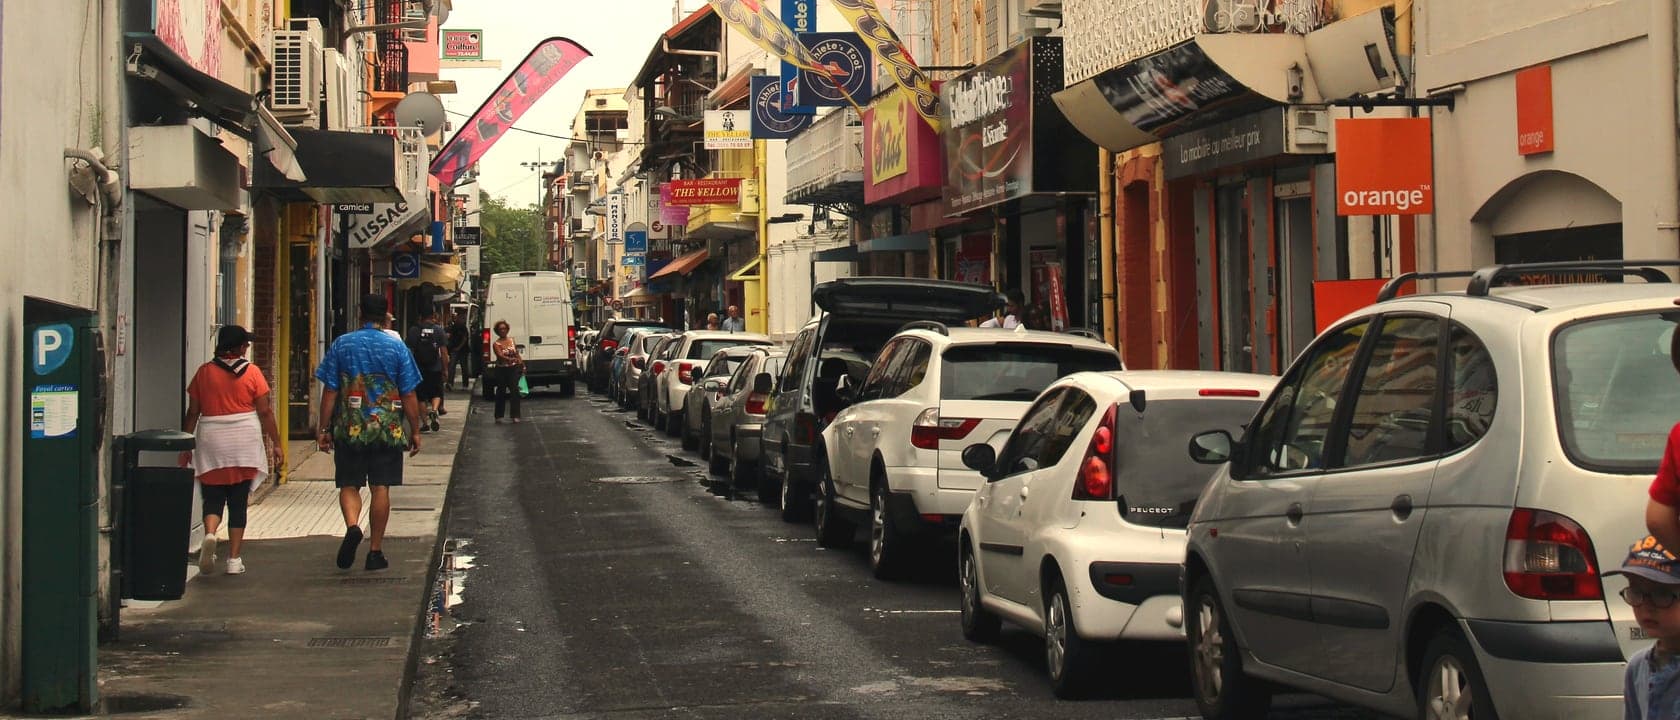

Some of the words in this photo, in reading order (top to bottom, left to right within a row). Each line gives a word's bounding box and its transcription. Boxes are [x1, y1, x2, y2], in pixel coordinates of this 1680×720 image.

[846, 47, 863, 71] Foot
[1246, 124, 1261, 153] prix
[1519, 130, 1544, 148] orange
[673, 188, 696, 198] THE
[696, 187, 739, 198] YELLOW
[1344, 190, 1424, 210] orange
[339, 203, 370, 212] camicie
[353, 197, 409, 244] LISSAC
[611, 204, 619, 239] MANSOUR
[38, 329, 63, 366] P
